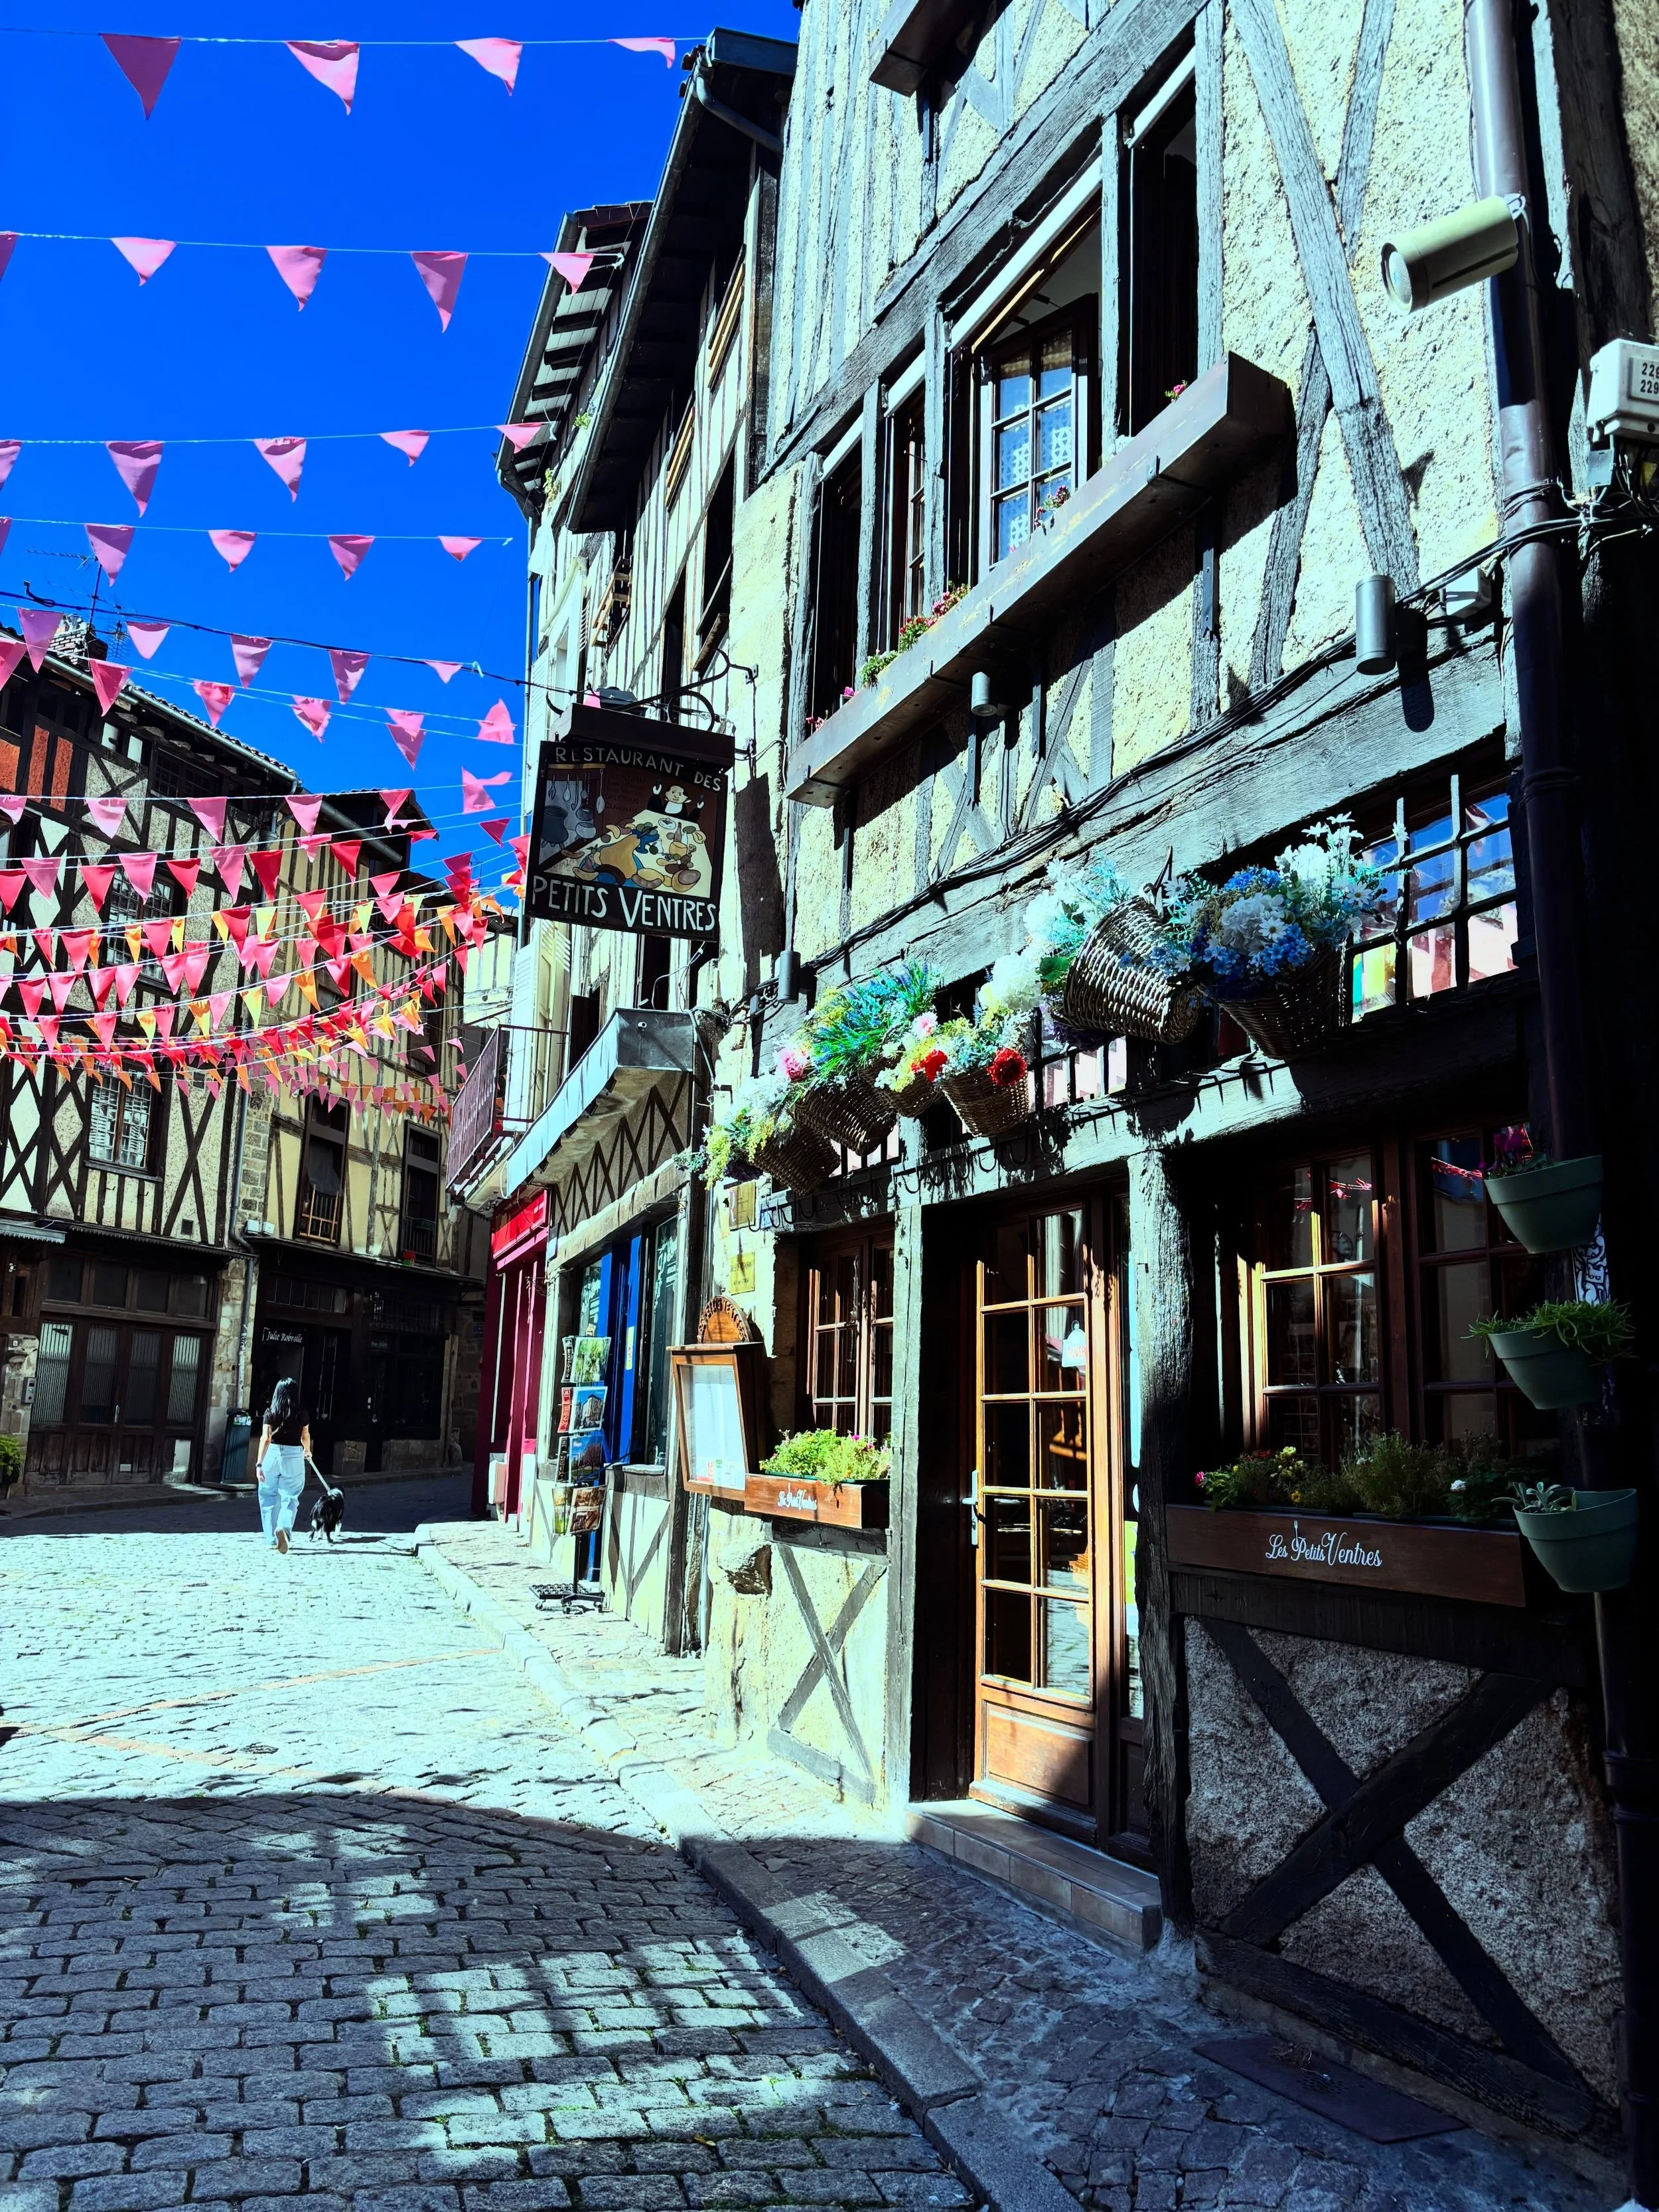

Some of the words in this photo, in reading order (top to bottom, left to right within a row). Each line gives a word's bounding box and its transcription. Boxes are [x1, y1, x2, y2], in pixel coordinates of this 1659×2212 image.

[555, 747, 684, 776] RESTAURANT
[694, 771, 721, 792] DES
[532, 876, 609, 918] PETITS
[618, 888, 716, 931] VENTRES
[266, 1331, 280, 1341] Julie
[1265, 1534, 1288, 1560] Les
[1291, 1530, 1326, 1561] Petits
[1321, 1532, 1382, 1567] Ventres
